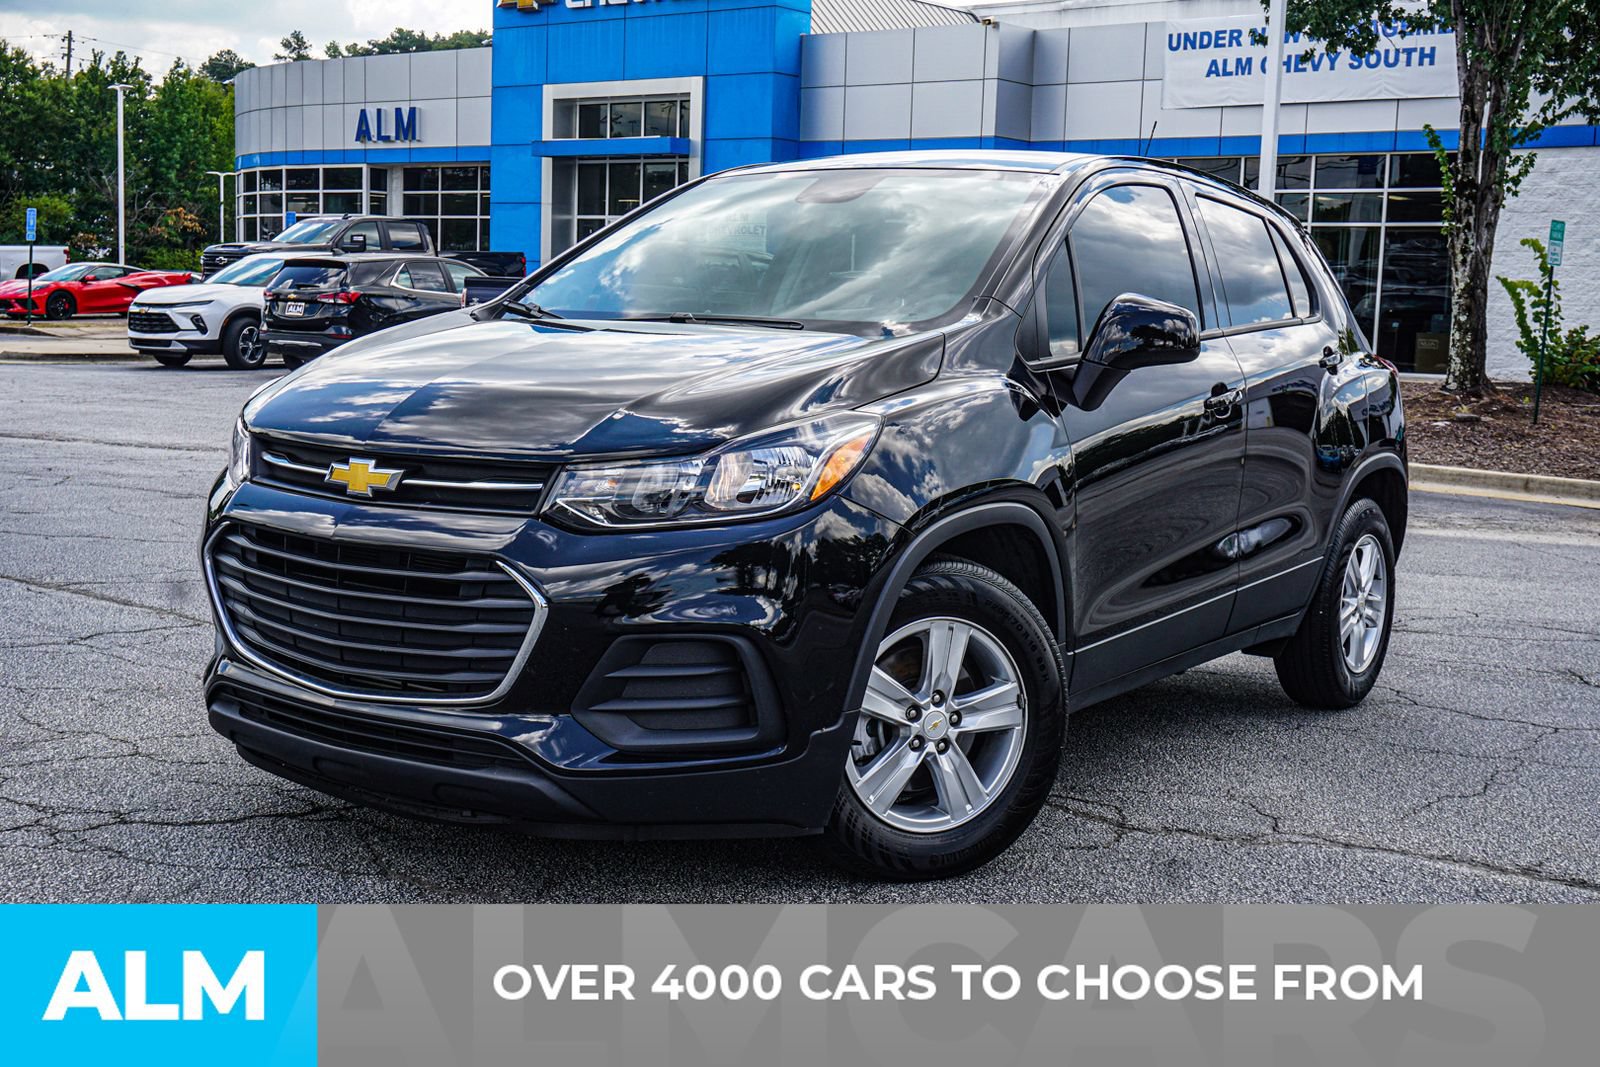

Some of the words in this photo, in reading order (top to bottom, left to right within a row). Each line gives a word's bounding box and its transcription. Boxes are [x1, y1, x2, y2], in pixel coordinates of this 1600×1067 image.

[1168, 28, 1243, 52] UNDER
[1205, 57, 1253, 78] ALM
[1348, 46, 1437, 70] SOUTH
[355, 106, 417, 142] ALM
[288, 304, 303, 313] ALM
